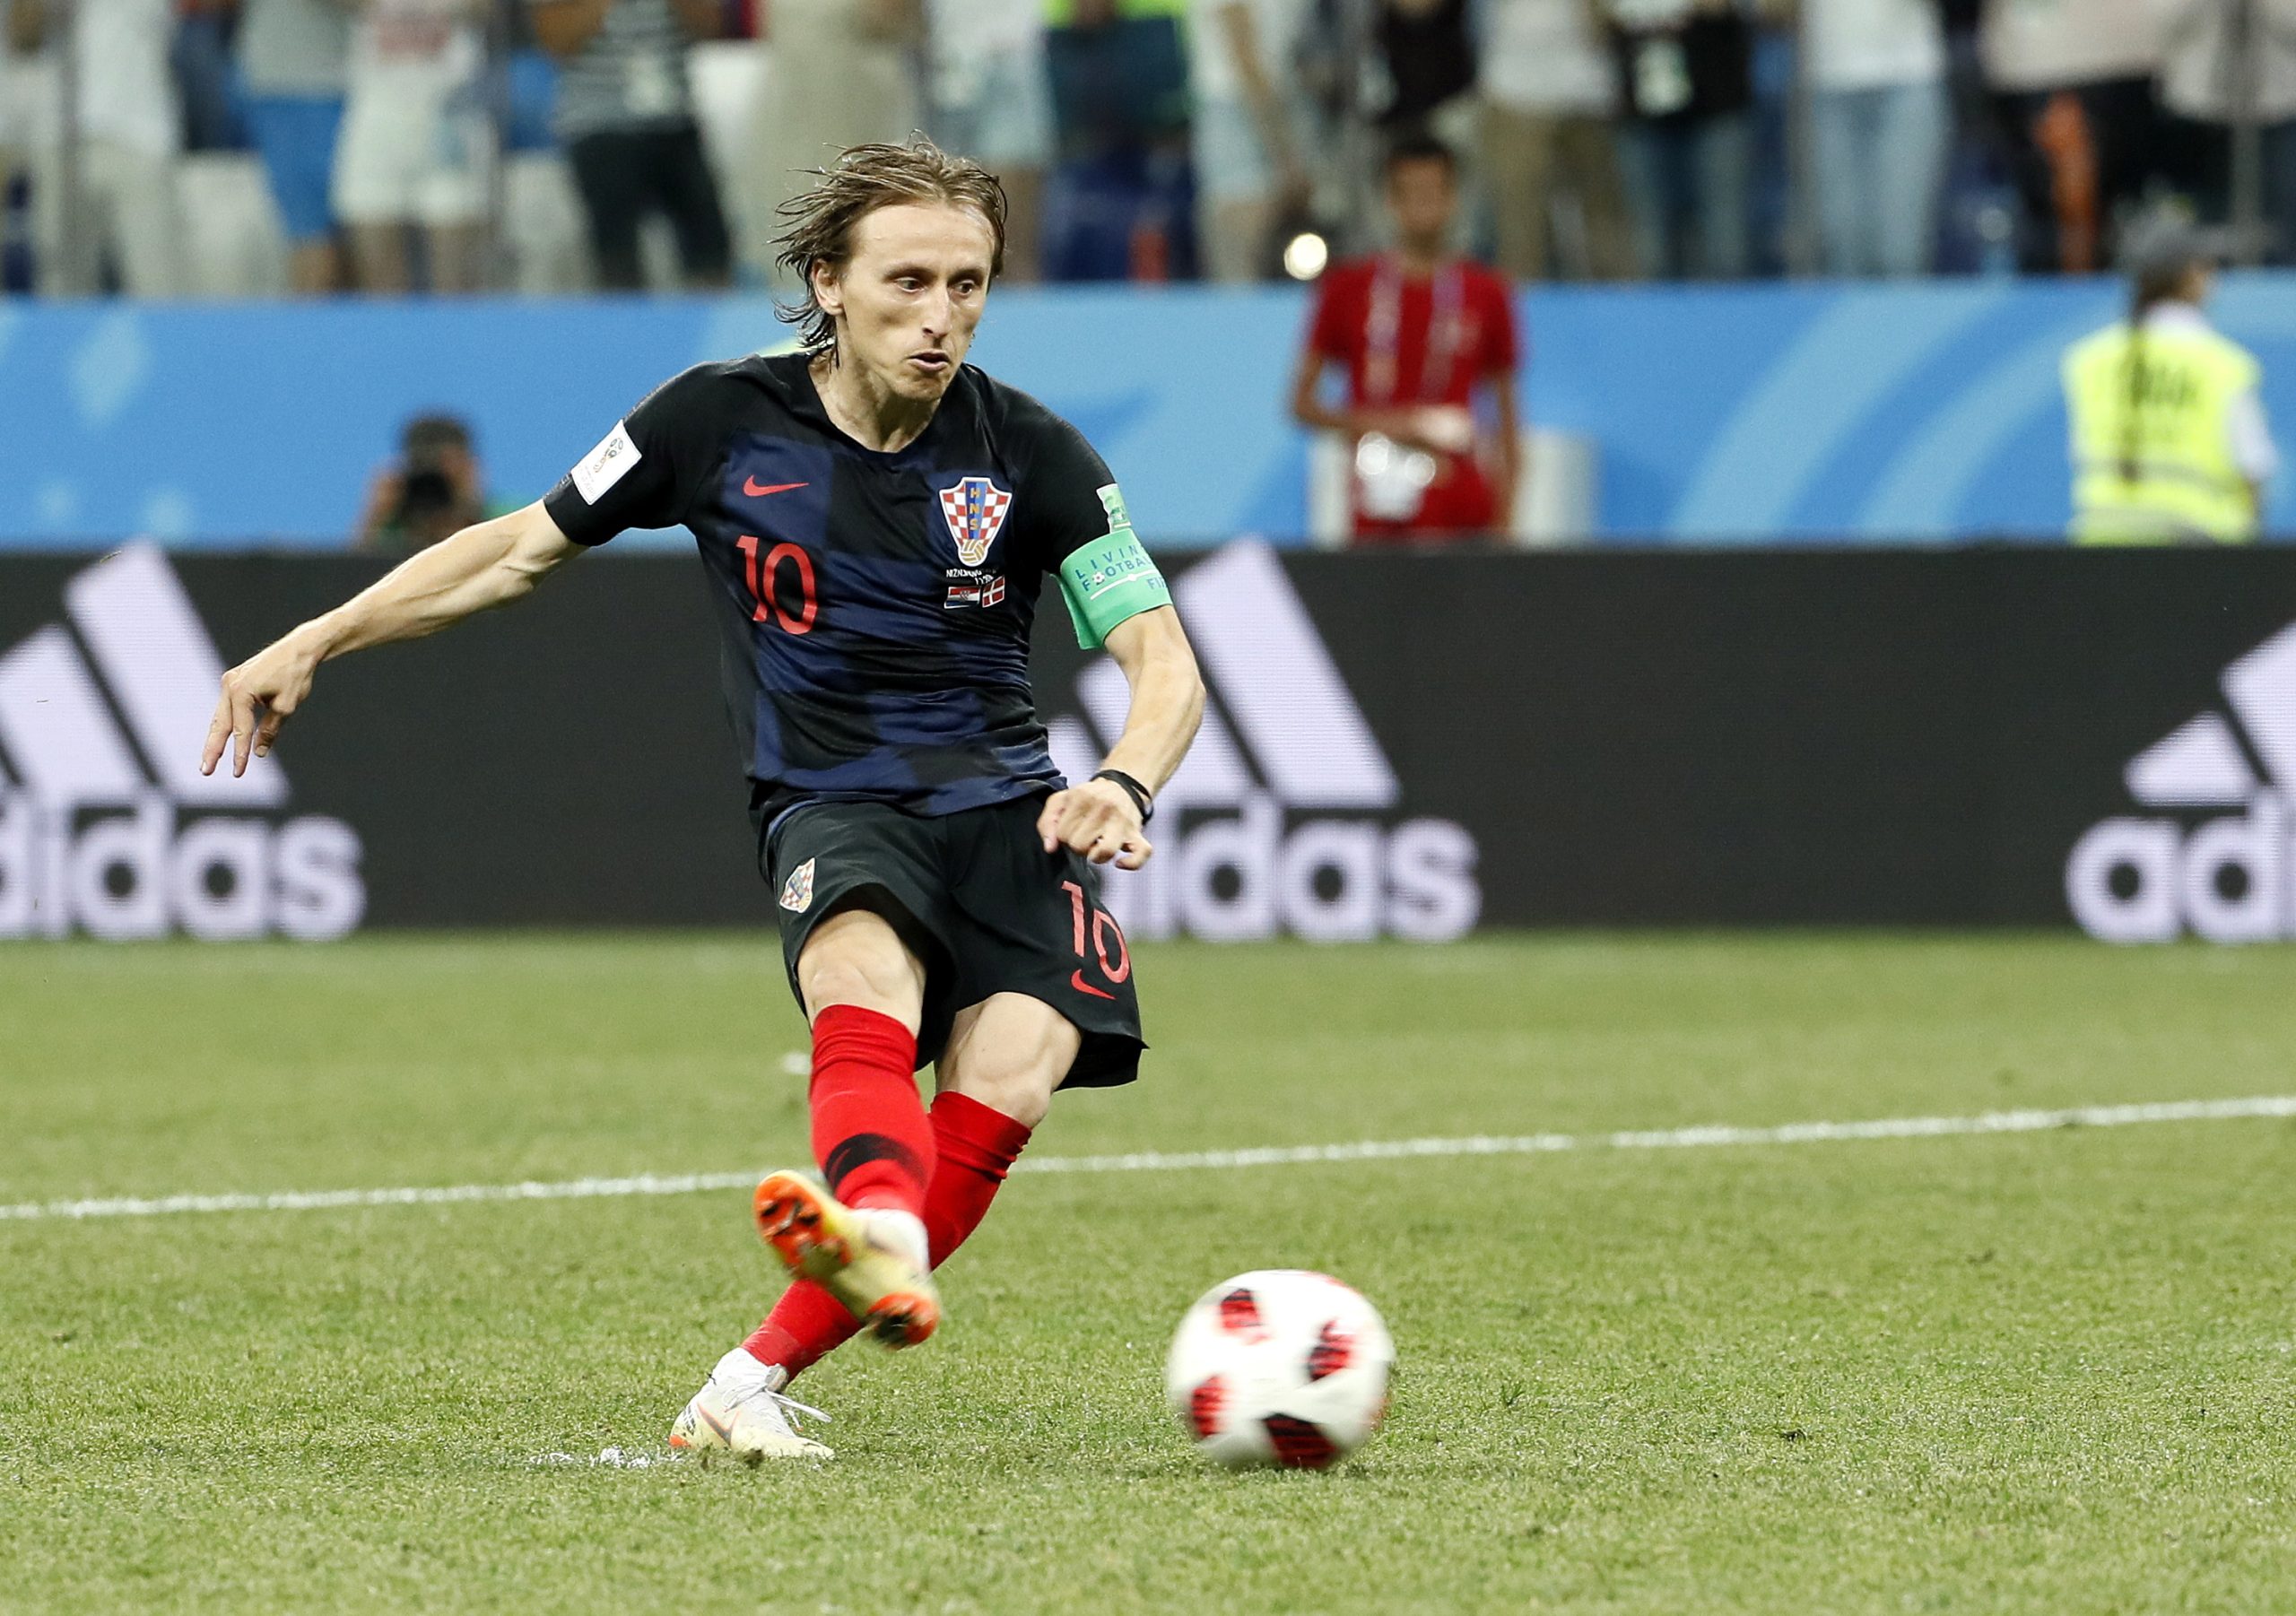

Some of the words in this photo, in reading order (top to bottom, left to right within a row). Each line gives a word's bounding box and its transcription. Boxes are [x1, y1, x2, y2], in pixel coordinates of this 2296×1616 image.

[969, 487, 980, 531] HNS
[735, 534, 818, 635] 10
[1074, 544, 1139, 579] LIVIN
[1082, 556, 1152, 592] FOOTBAL
[1100, 791, 1483, 943] idas
[1061, 880, 1132, 985] 10
